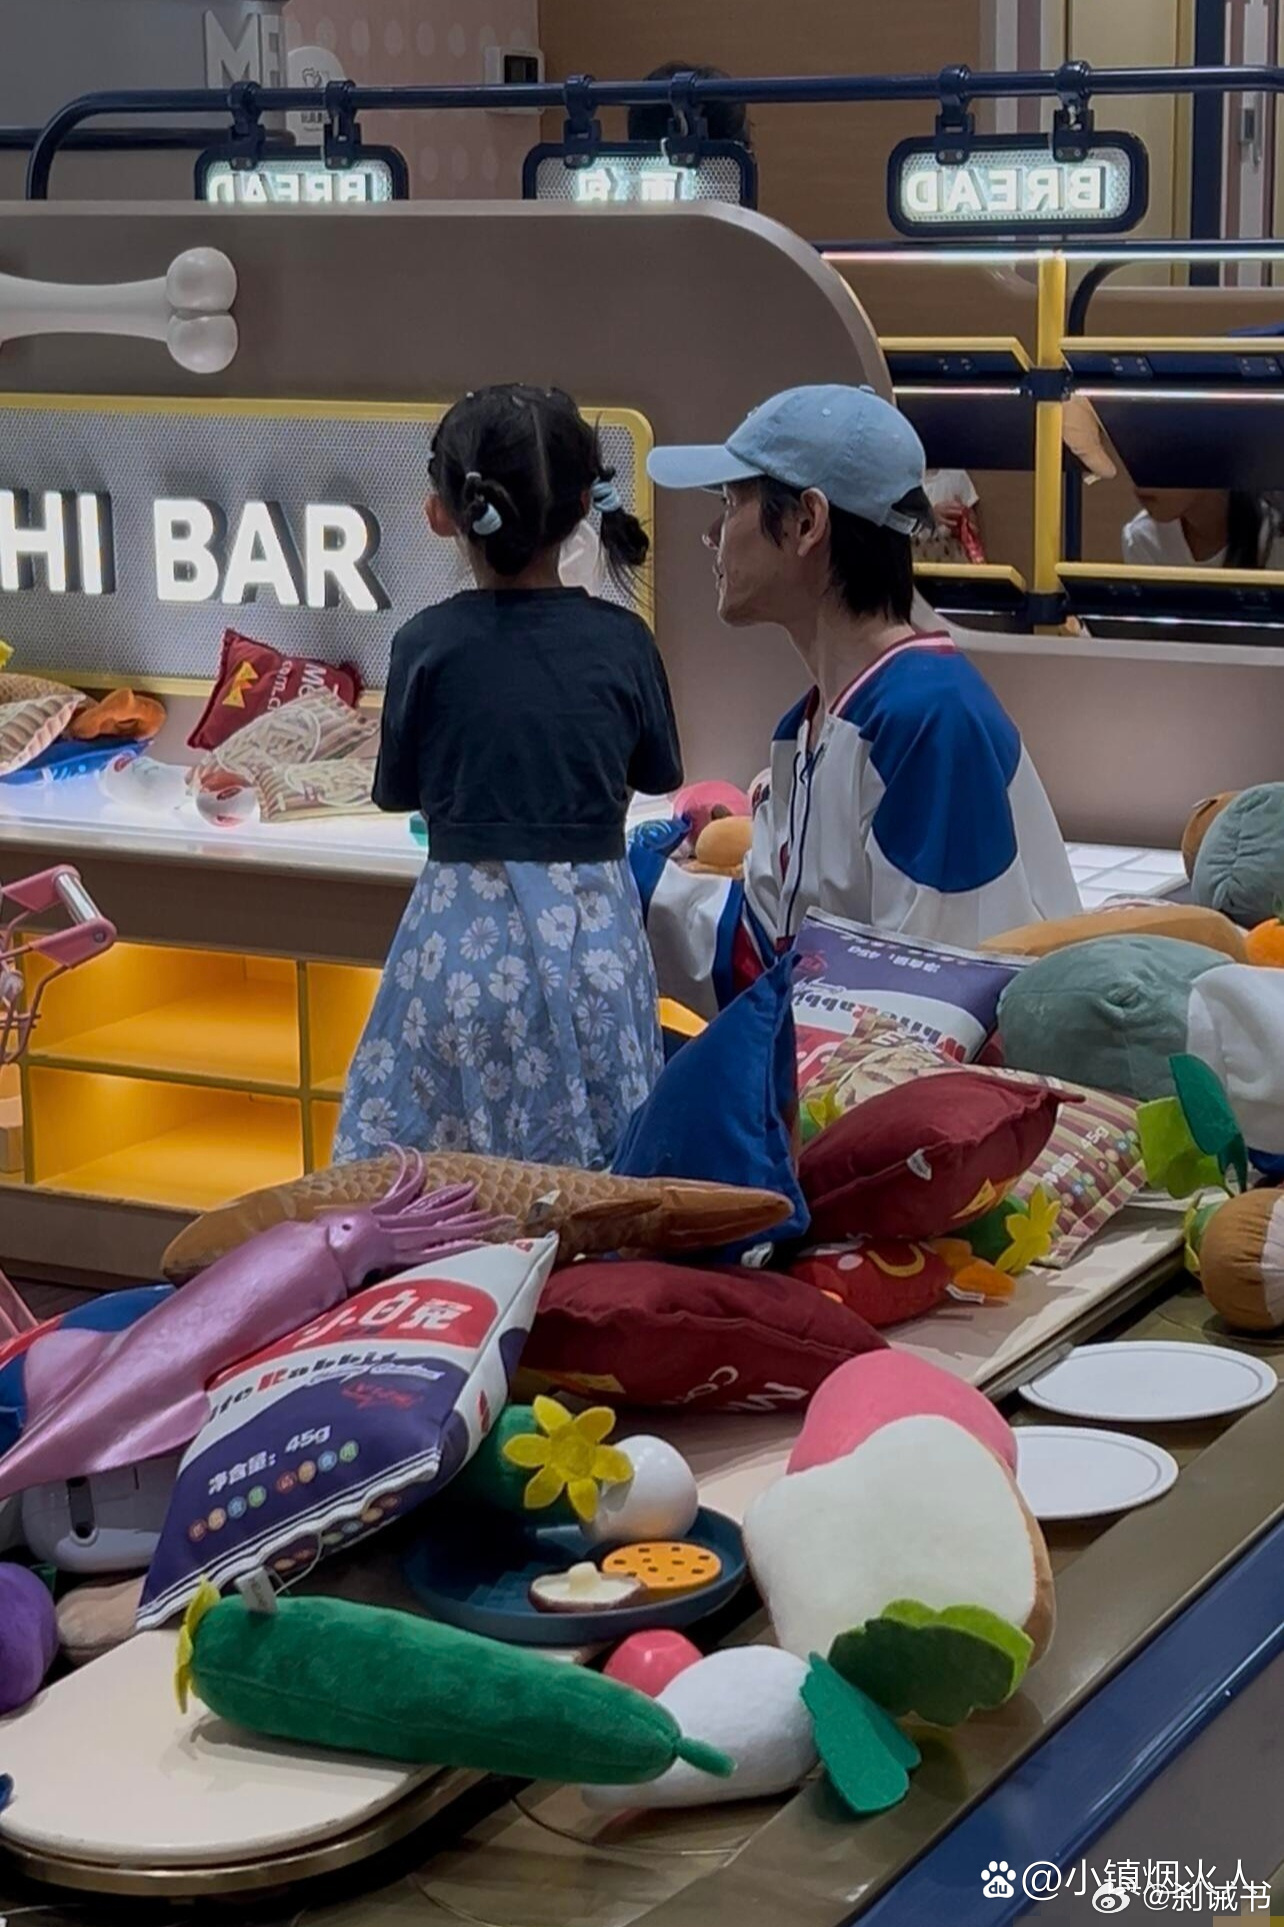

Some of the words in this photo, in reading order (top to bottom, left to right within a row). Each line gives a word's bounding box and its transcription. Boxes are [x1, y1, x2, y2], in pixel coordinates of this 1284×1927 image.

[154, 499, 378, 612] BAR
[1080, 1126, 1109, 1150] 45g
[284, 1425, 332, 1454] 45g
